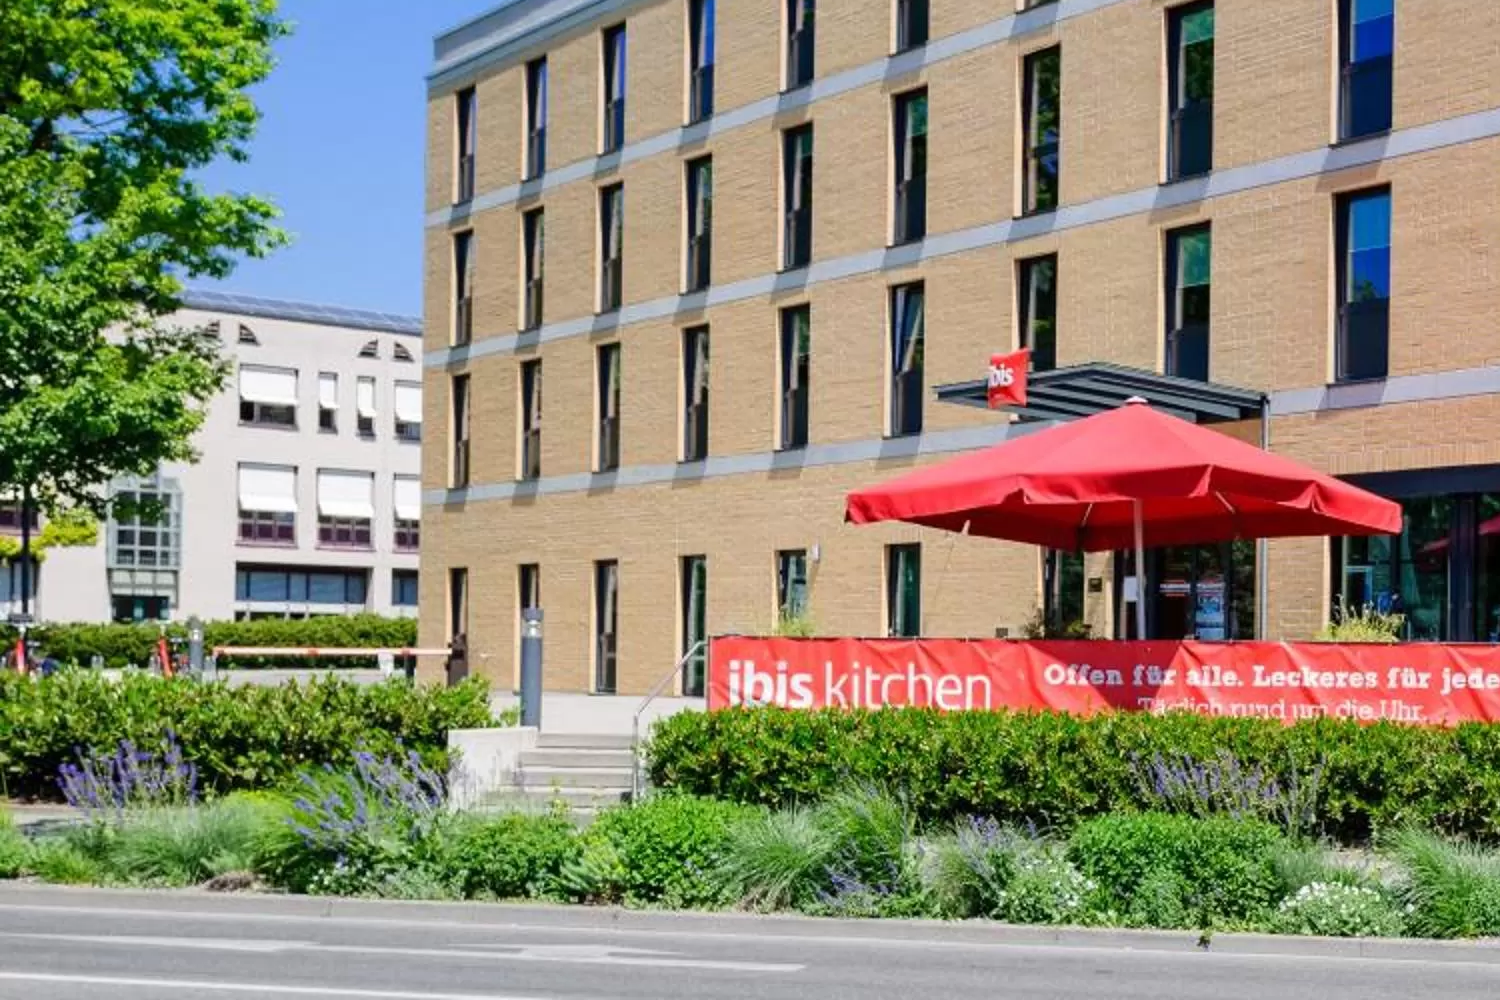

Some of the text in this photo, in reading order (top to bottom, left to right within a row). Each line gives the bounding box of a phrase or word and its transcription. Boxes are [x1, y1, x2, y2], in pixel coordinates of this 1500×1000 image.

[728, 659, 992, 711] ibis kitchen
[1044, 663, 1124, 686] Offen
[1132, 664, 1177, 686] für
[1186, 665, 1244, 688] alle.
[1252, 665, 1378, 689] Leckeres
[1387, 666, 1431, 689] für
[1230, 699, 1285, 719] rund
[1336, 699, 1375, 721] die
